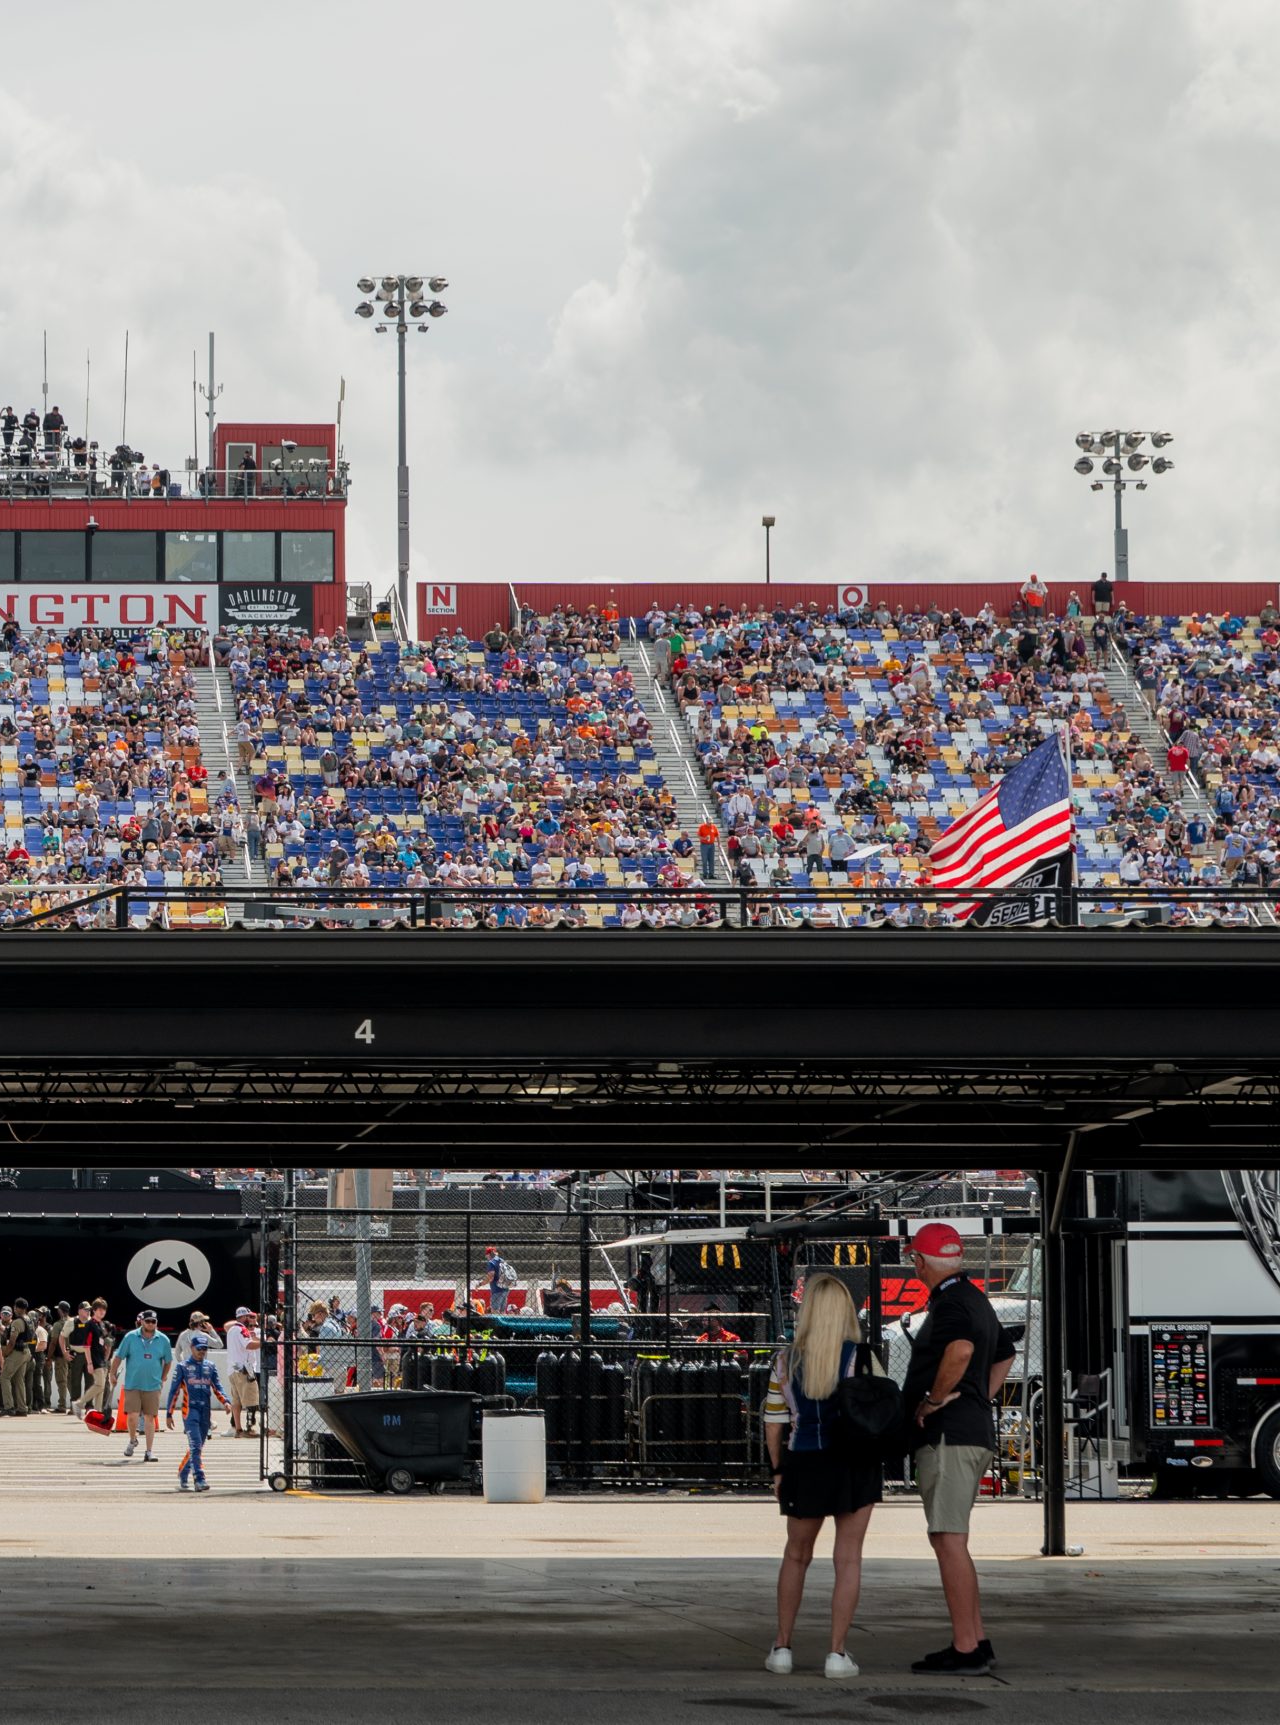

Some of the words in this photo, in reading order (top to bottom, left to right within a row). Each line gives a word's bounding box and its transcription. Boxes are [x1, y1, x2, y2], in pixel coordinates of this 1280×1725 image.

[227, 588, 297, 607] DARLINGTON
[432, 586, 451, 606] N
[842, 586, 863, 607] O
[354, 1018, 375, 1044] 4
[383, 1414, 401, 1426] RM
